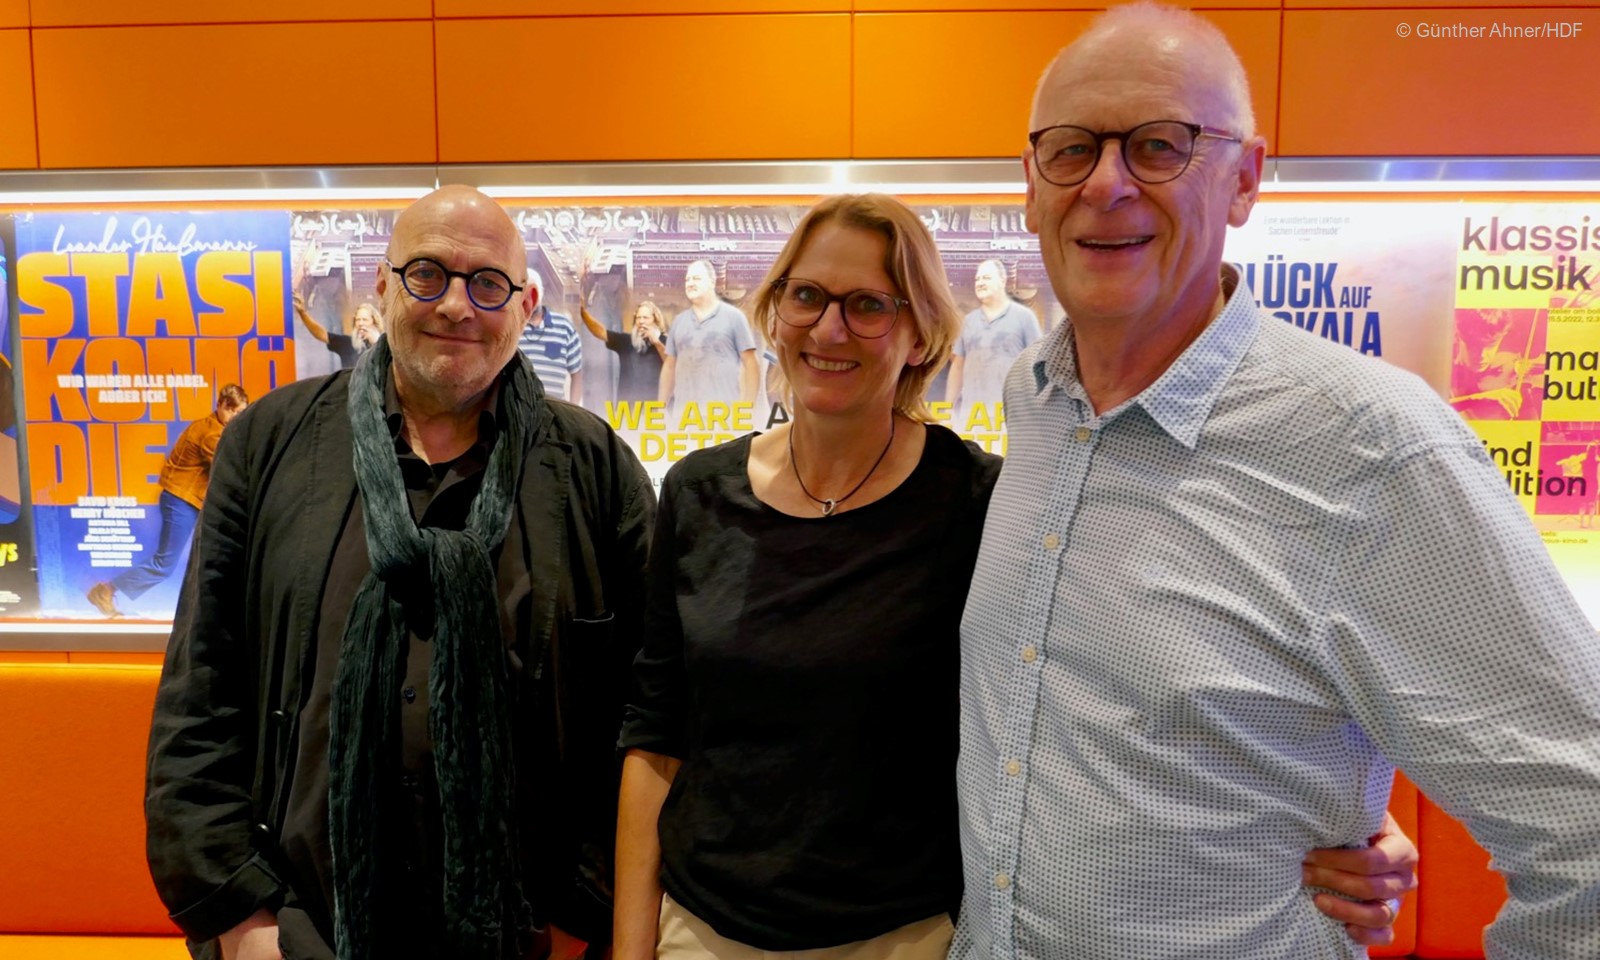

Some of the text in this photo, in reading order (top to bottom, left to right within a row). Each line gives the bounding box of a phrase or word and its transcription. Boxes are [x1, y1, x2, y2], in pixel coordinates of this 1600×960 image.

[53, 216, 132, 256] Leander
[1234, 254, 1372, 309] LÜCK AUF
[1460, 255, 1592, 291] musik
[16, 251, 285, 337] STASI
[57, 375, 84, 388] WIR
[85, 375, 131, 388] WAREN
[134, 375, 164, 388] ALLE
[605, 401, 667, 431] WE
[677, 401, 754, 431] ARE
[924, 401, 953, 431] E
[26, 422, 168, 505] DIE
